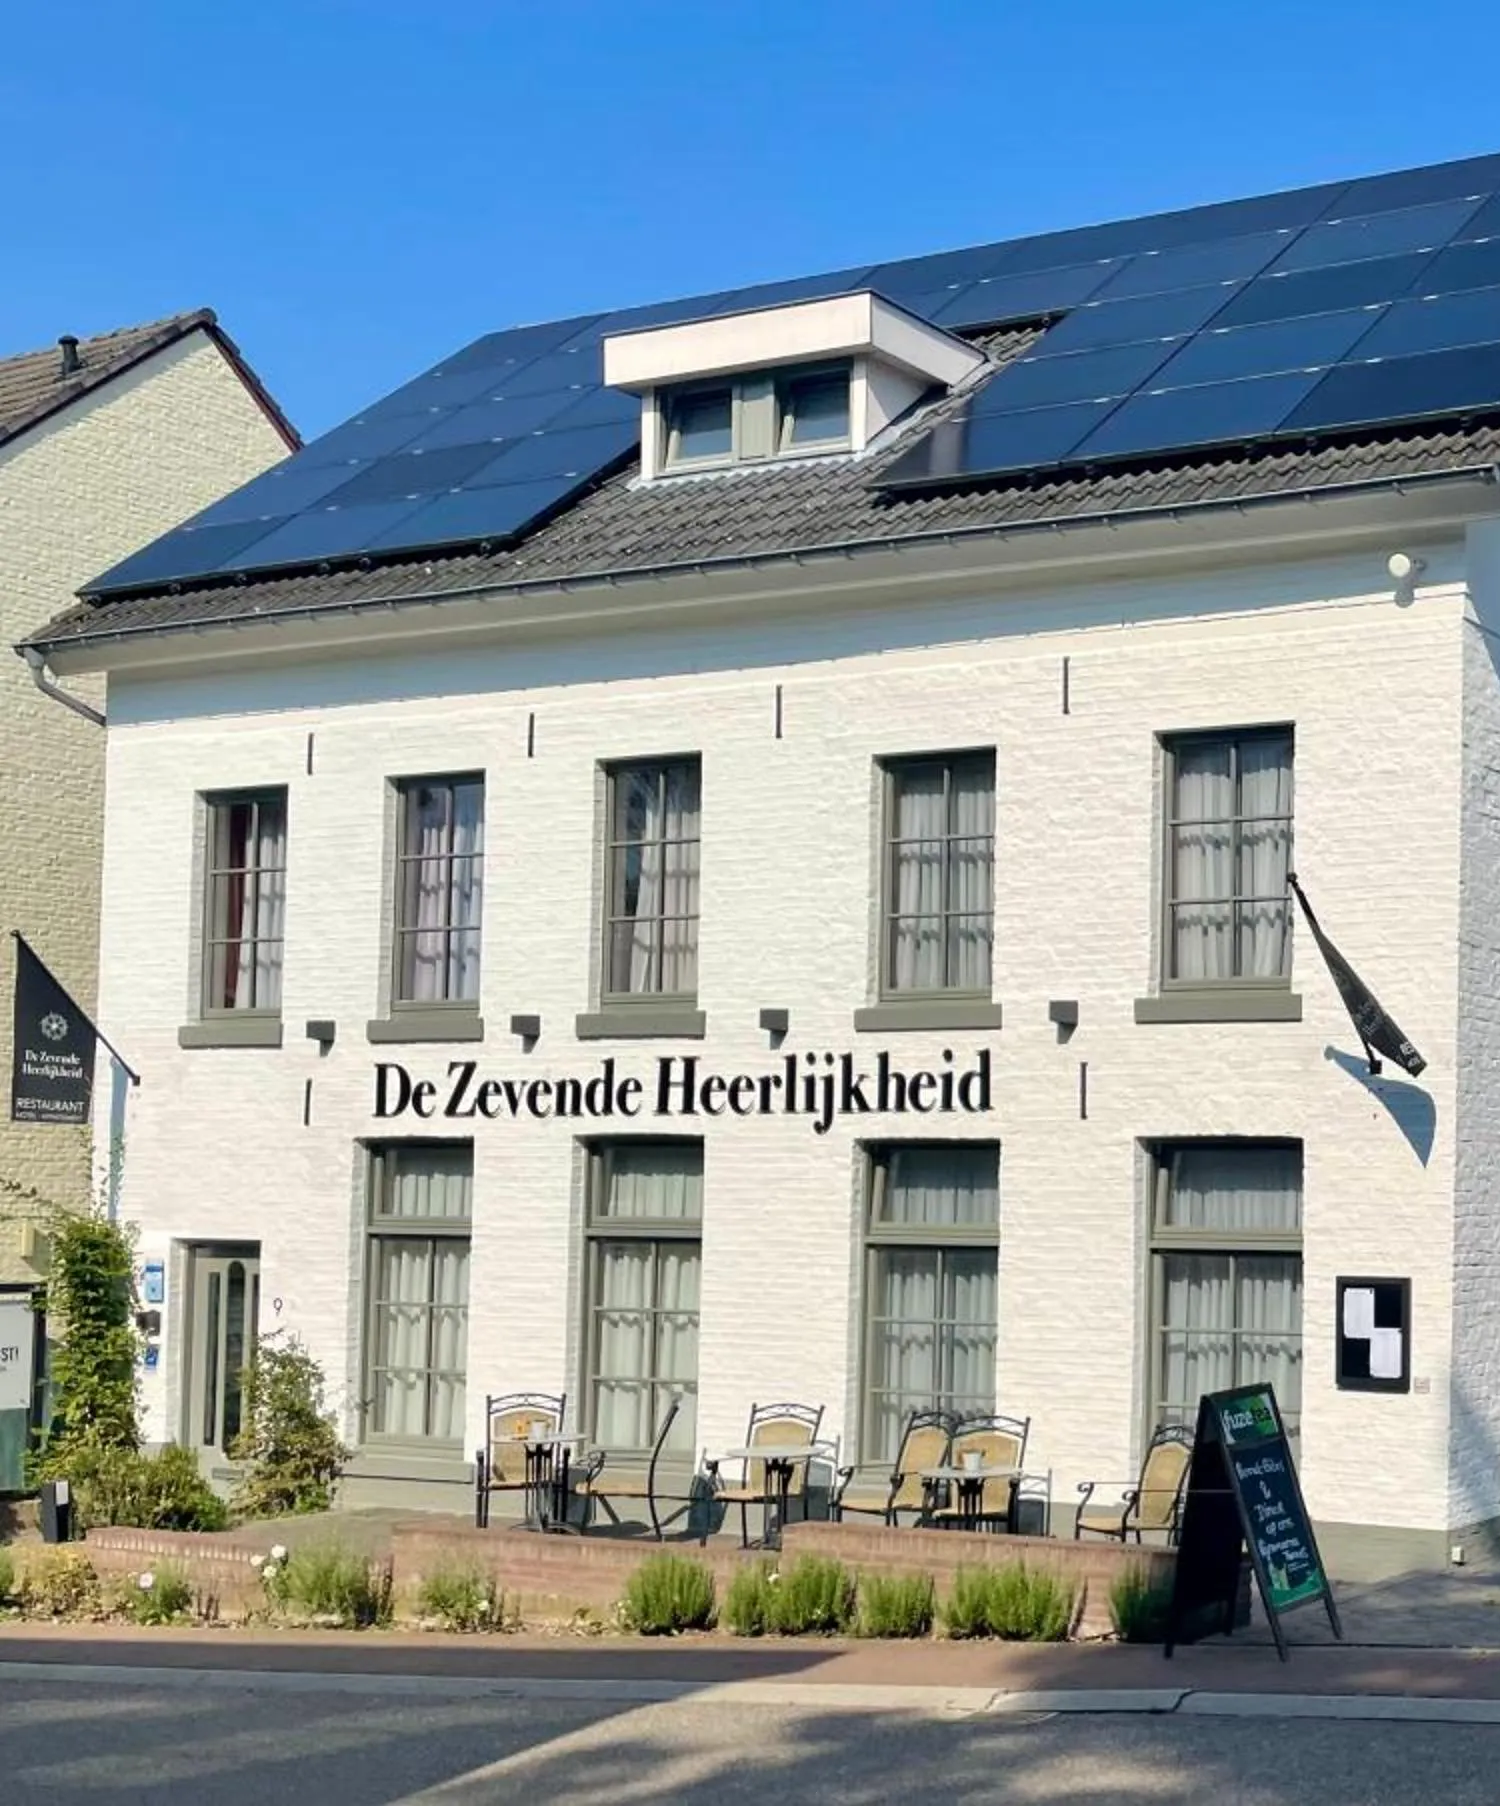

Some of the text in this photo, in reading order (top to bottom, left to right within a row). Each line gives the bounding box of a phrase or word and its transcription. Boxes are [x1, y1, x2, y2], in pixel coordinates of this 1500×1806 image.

[16, 1097, 85, 1112] RESTAURANT
[372, 1048, 992, 1135] De Zevende Heerlijkheid
